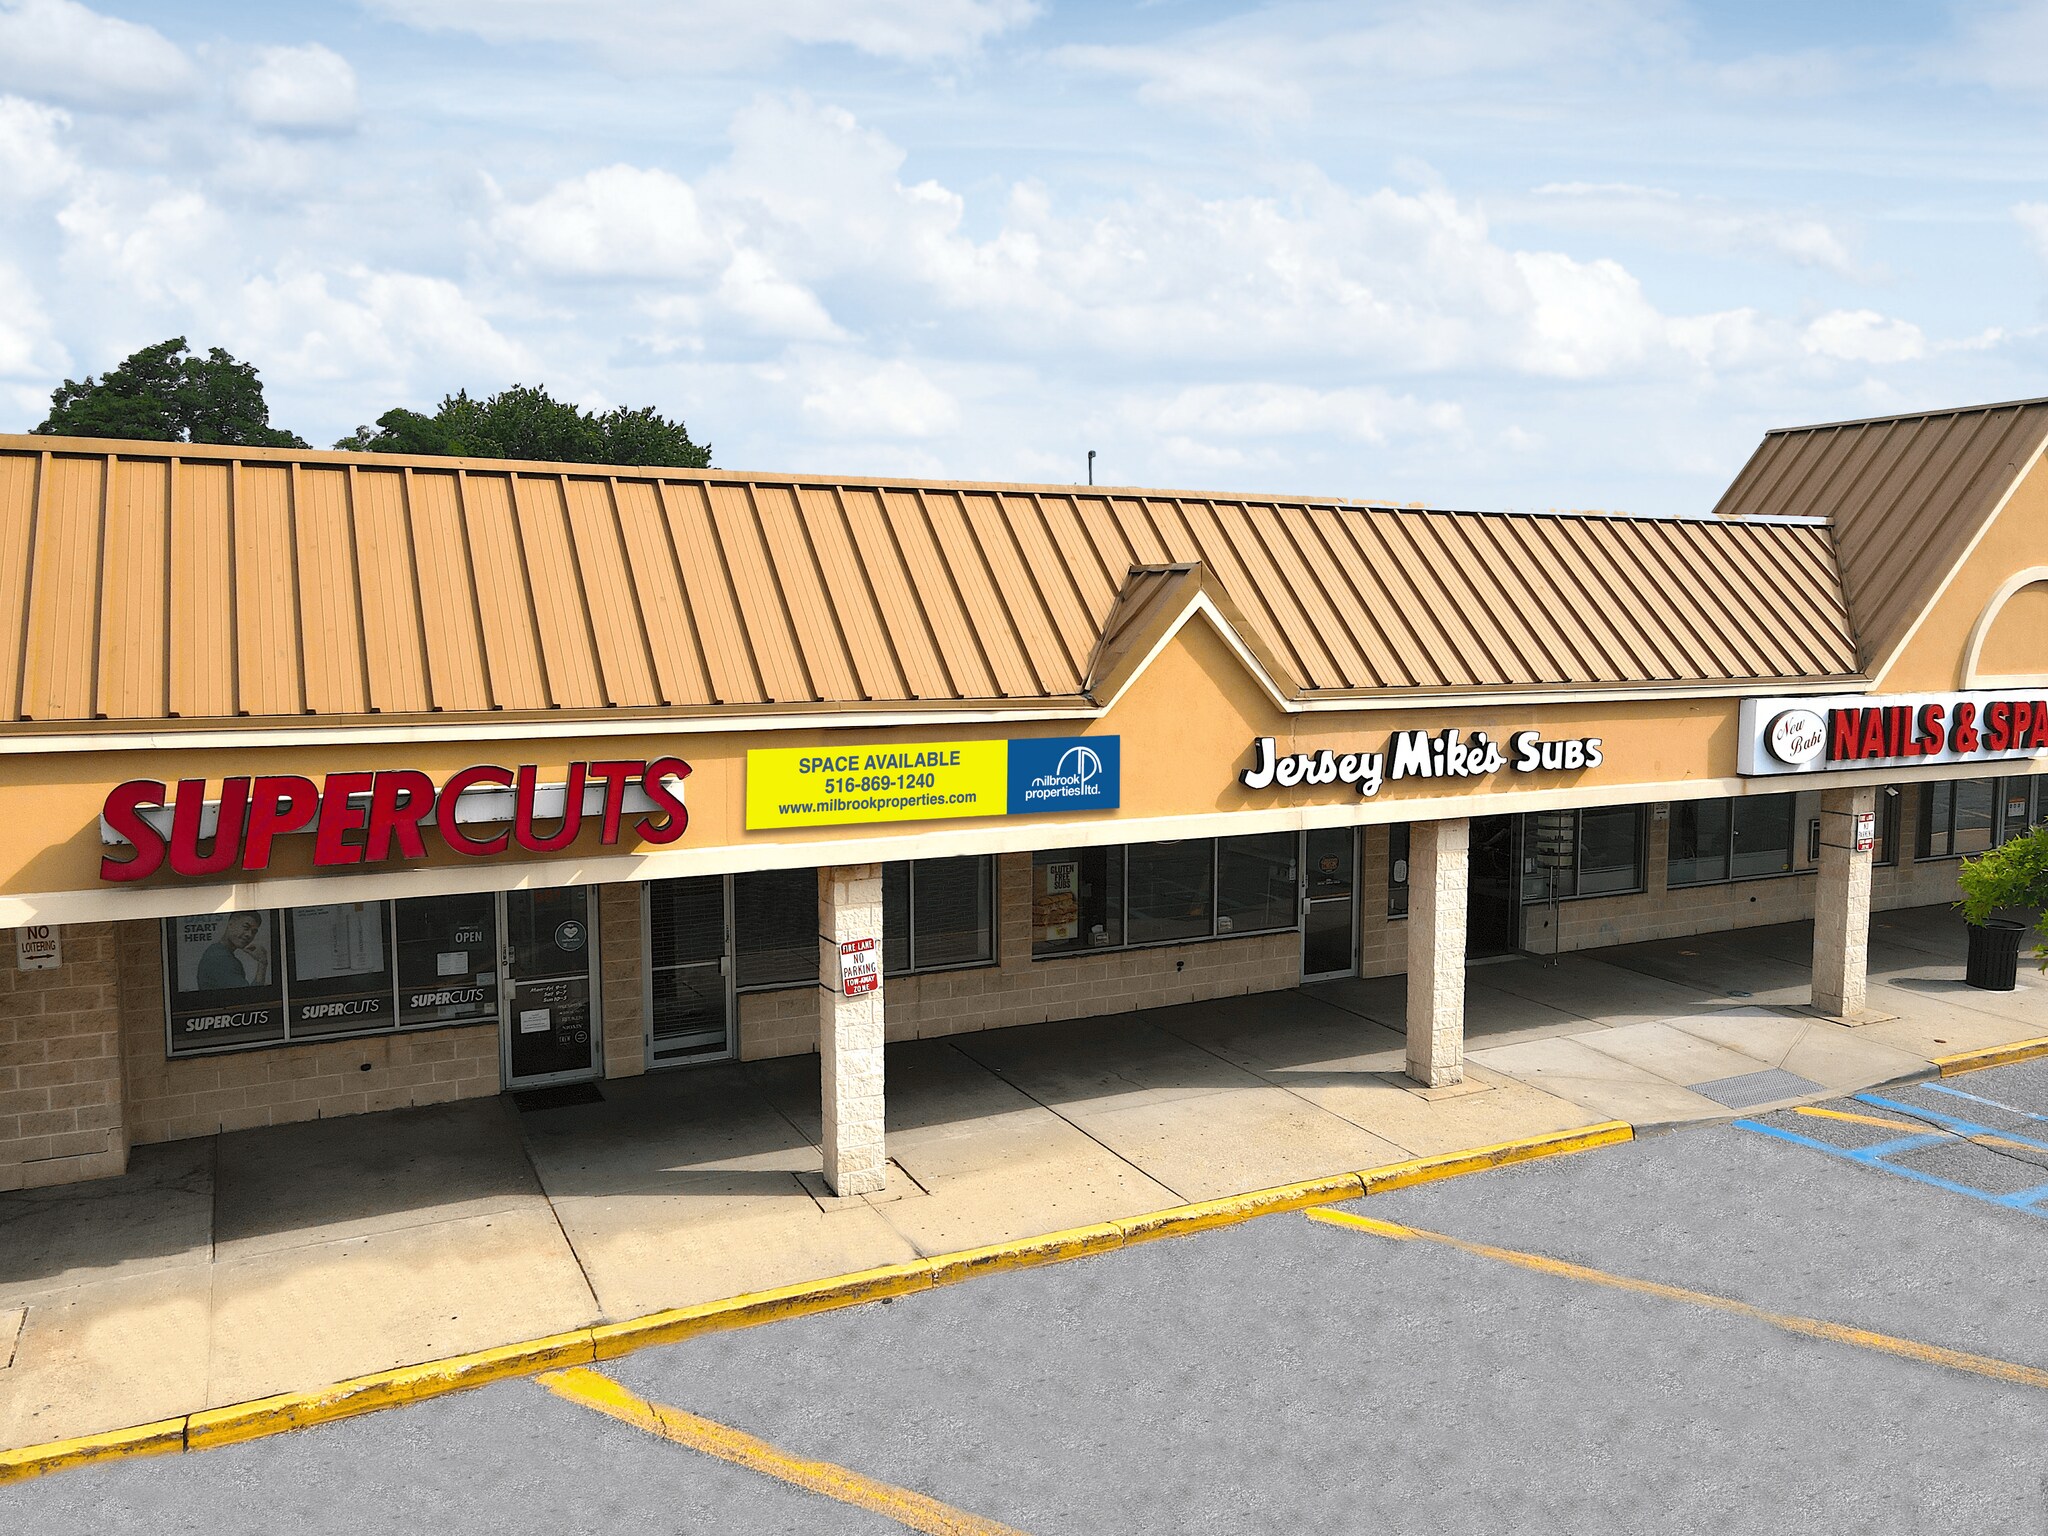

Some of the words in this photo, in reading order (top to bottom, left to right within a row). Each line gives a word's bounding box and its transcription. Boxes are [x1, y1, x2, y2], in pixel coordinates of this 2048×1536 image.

[1776, 716, 1805, 741] New
[1827, 704, 1945, 761] NAILS
[1949, 702, 1980, 753] &
[1984, 700, 2048, 751] SPA
[798, 754, 860, 774] SPACE
[863, 750, 961, 771] AVAILABLE
[1240, 736, 1384, 798] Jersey
[1387, 729, 1508, 781] Mike's
[824, 773, 935, 794] 516-869-1240
[1031, 774, 1080, 787] milbrook
[1025, 785, 1081, 801] properties
[778, 791, 977, 815] www.milbrookproperties.com
[100, 755, 692, 882] SUPERCUTS
[1050, 864, 1075, 875] GLUTEN
[1053, 880, 1071, 890] SUBS
[1054, 873, 1071, 882] FREE
[27, 925, 50, 940] NO
[184, 922, 218, 933] START
[184, 933, 213, 942] HERE
[455, 931, 482, 943] OPEN
[21, 940, 56, 953] LOITERING
[842, 943, 856, 954] FIRE
[857, 940, 874, 950] LANE
[853, 952, 865, 965] NO
[843, 962, 876, 978] PARKING
[853, 983, 871, 994] ZONE
[410, 988, 484, 1009] SUPERCUTS
[301, 999, 380, 1020] SUPERCUTS
[185, 1010, 270, 1033] SUPERCUTS
